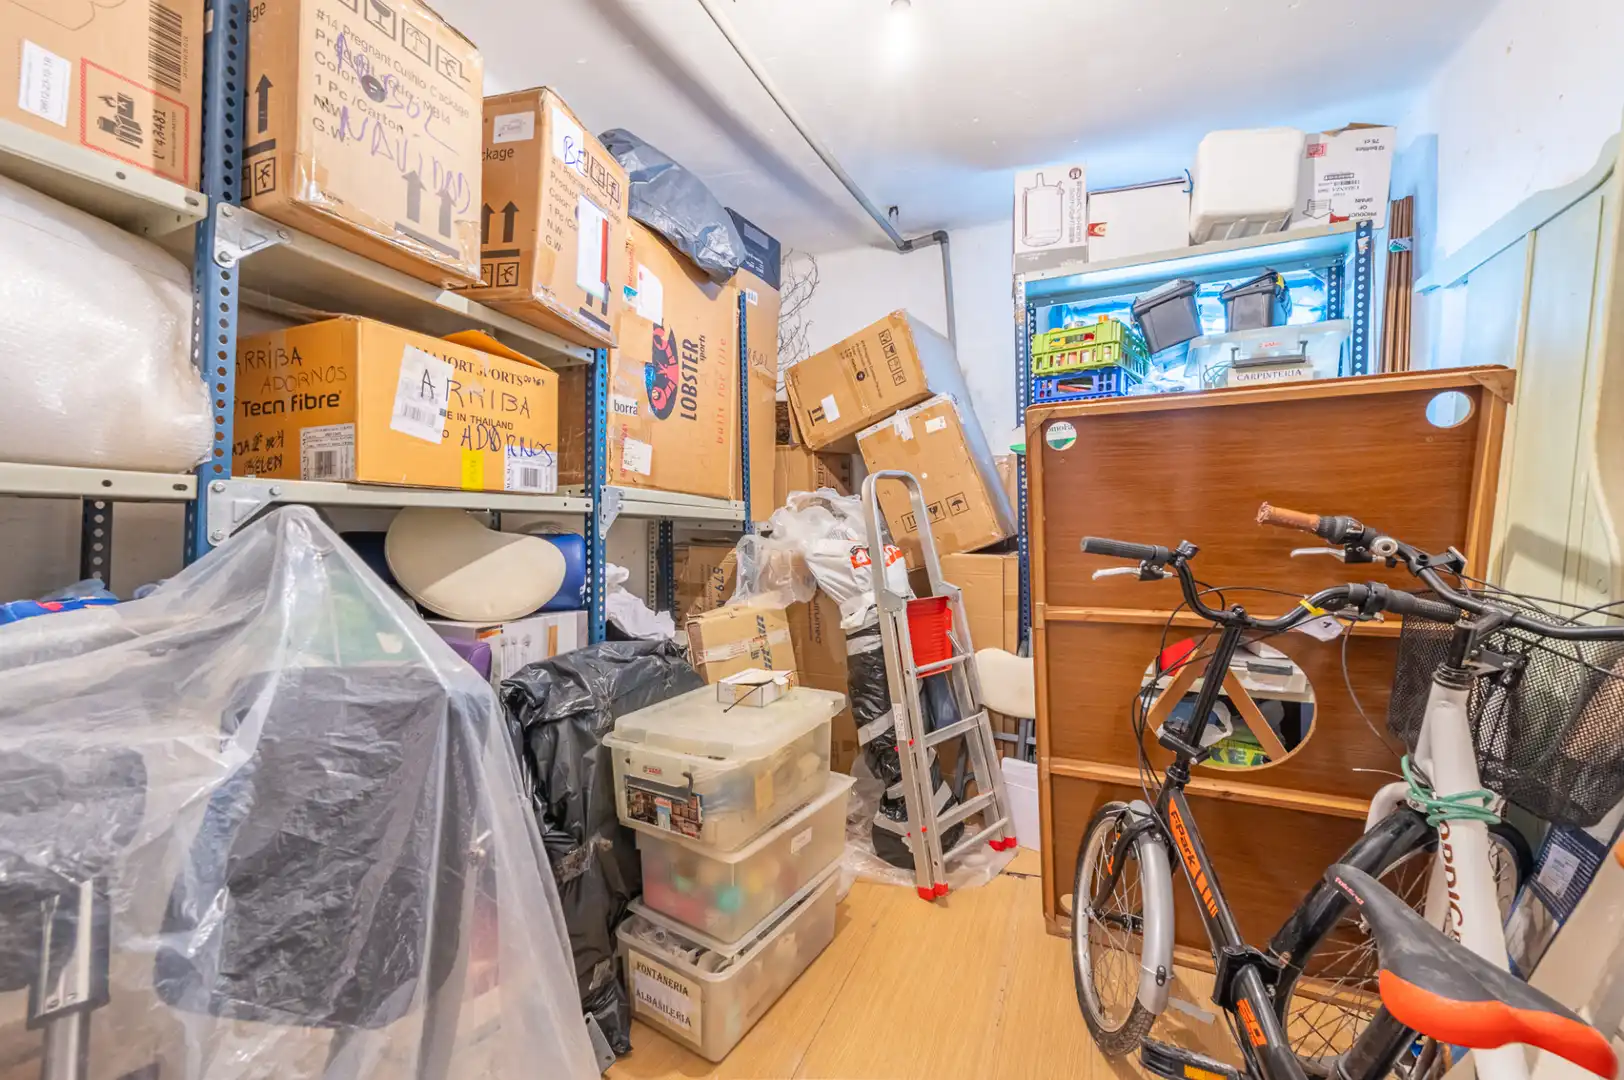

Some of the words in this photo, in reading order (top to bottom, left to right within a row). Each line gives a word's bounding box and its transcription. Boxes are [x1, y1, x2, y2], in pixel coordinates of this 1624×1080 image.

[342, 24, 391, 68] Pregnant
[260, 365, 347, 395] ADORNOS
[680, 338, 698, 421] LOBSTER
[1236, 368, 1302, 381] CARPINTERIA
[456, 412, 467, 422] IN
[470, 415, 514, 430] THAILAND
[636, 961, 689, 997] FONTANERIA
